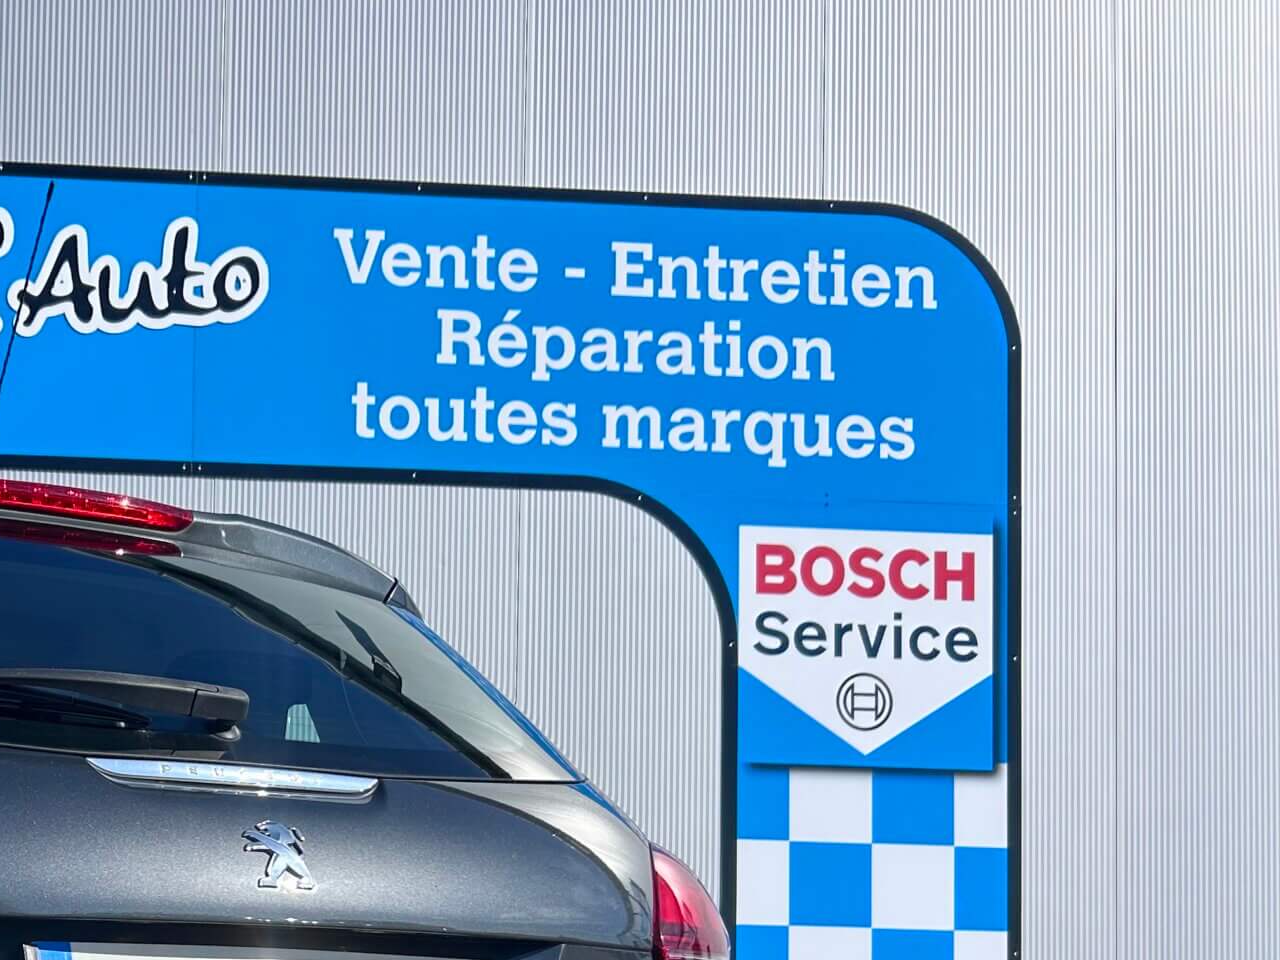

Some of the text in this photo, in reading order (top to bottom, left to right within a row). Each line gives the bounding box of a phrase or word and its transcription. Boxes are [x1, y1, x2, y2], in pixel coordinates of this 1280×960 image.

[333, 228, 538, 292] Vente
[611, 241, 938, 309] Entretien
[436, 309, 835, 381] Réparation
[351, 382, 915, 468] toutes marques
[755, 543, 976, 601] BOSCH
[753, 610, 979, 663] Service
